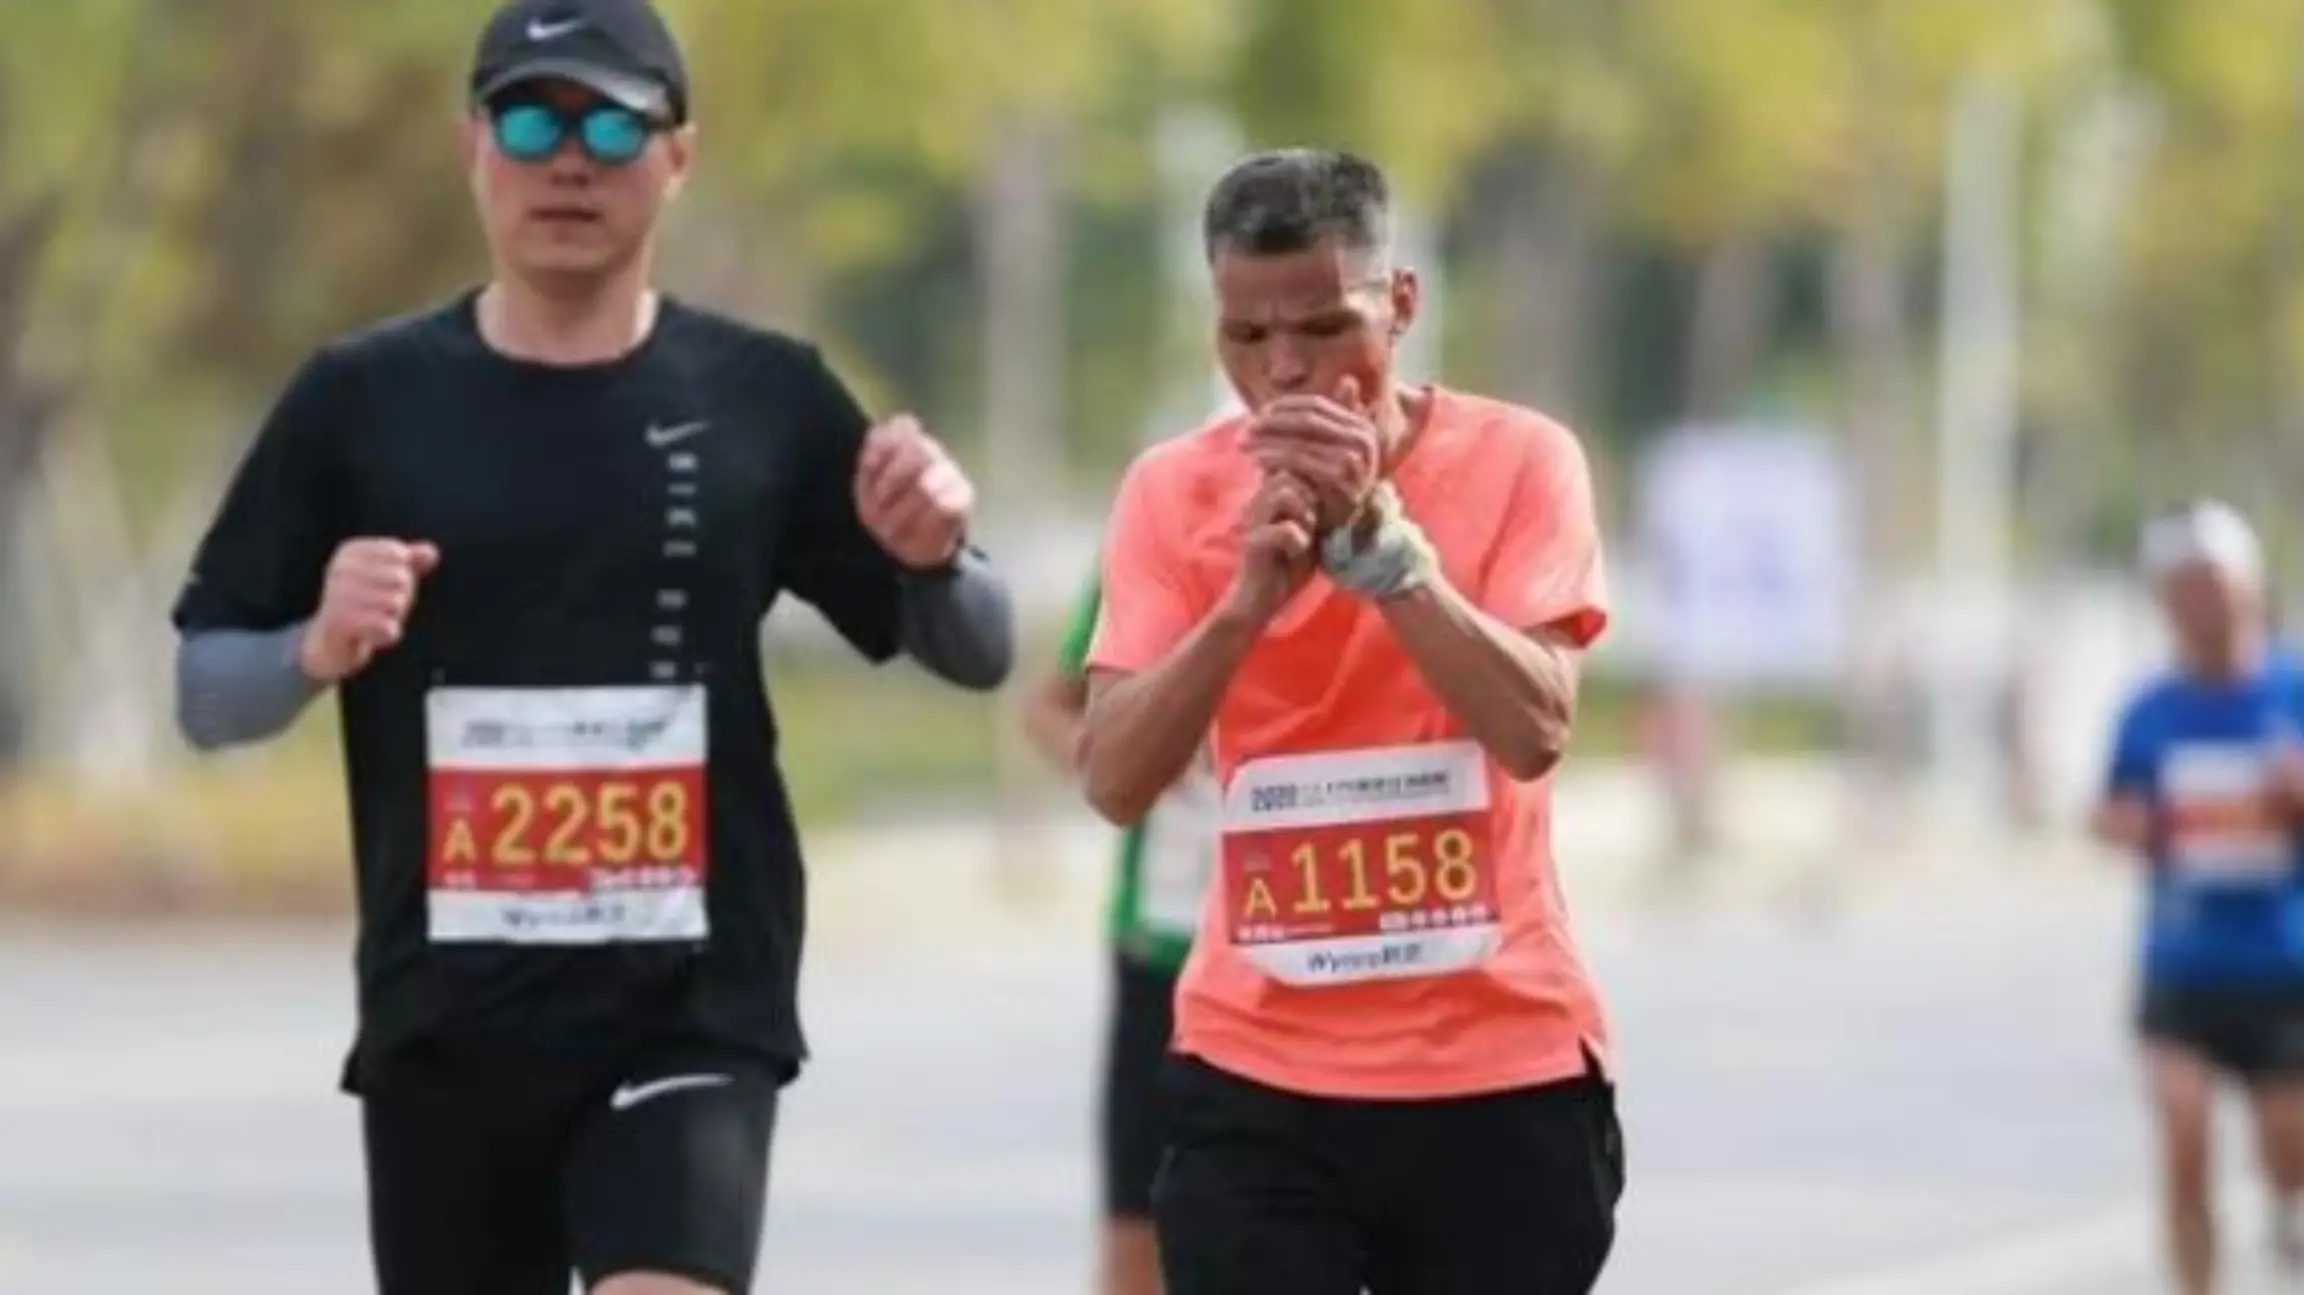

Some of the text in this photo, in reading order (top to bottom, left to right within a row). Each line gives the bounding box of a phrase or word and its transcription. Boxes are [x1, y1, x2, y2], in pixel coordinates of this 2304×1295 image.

[443, 781, 689, 865] A 2258
[1243, 828, 1478, 919] A 1158
